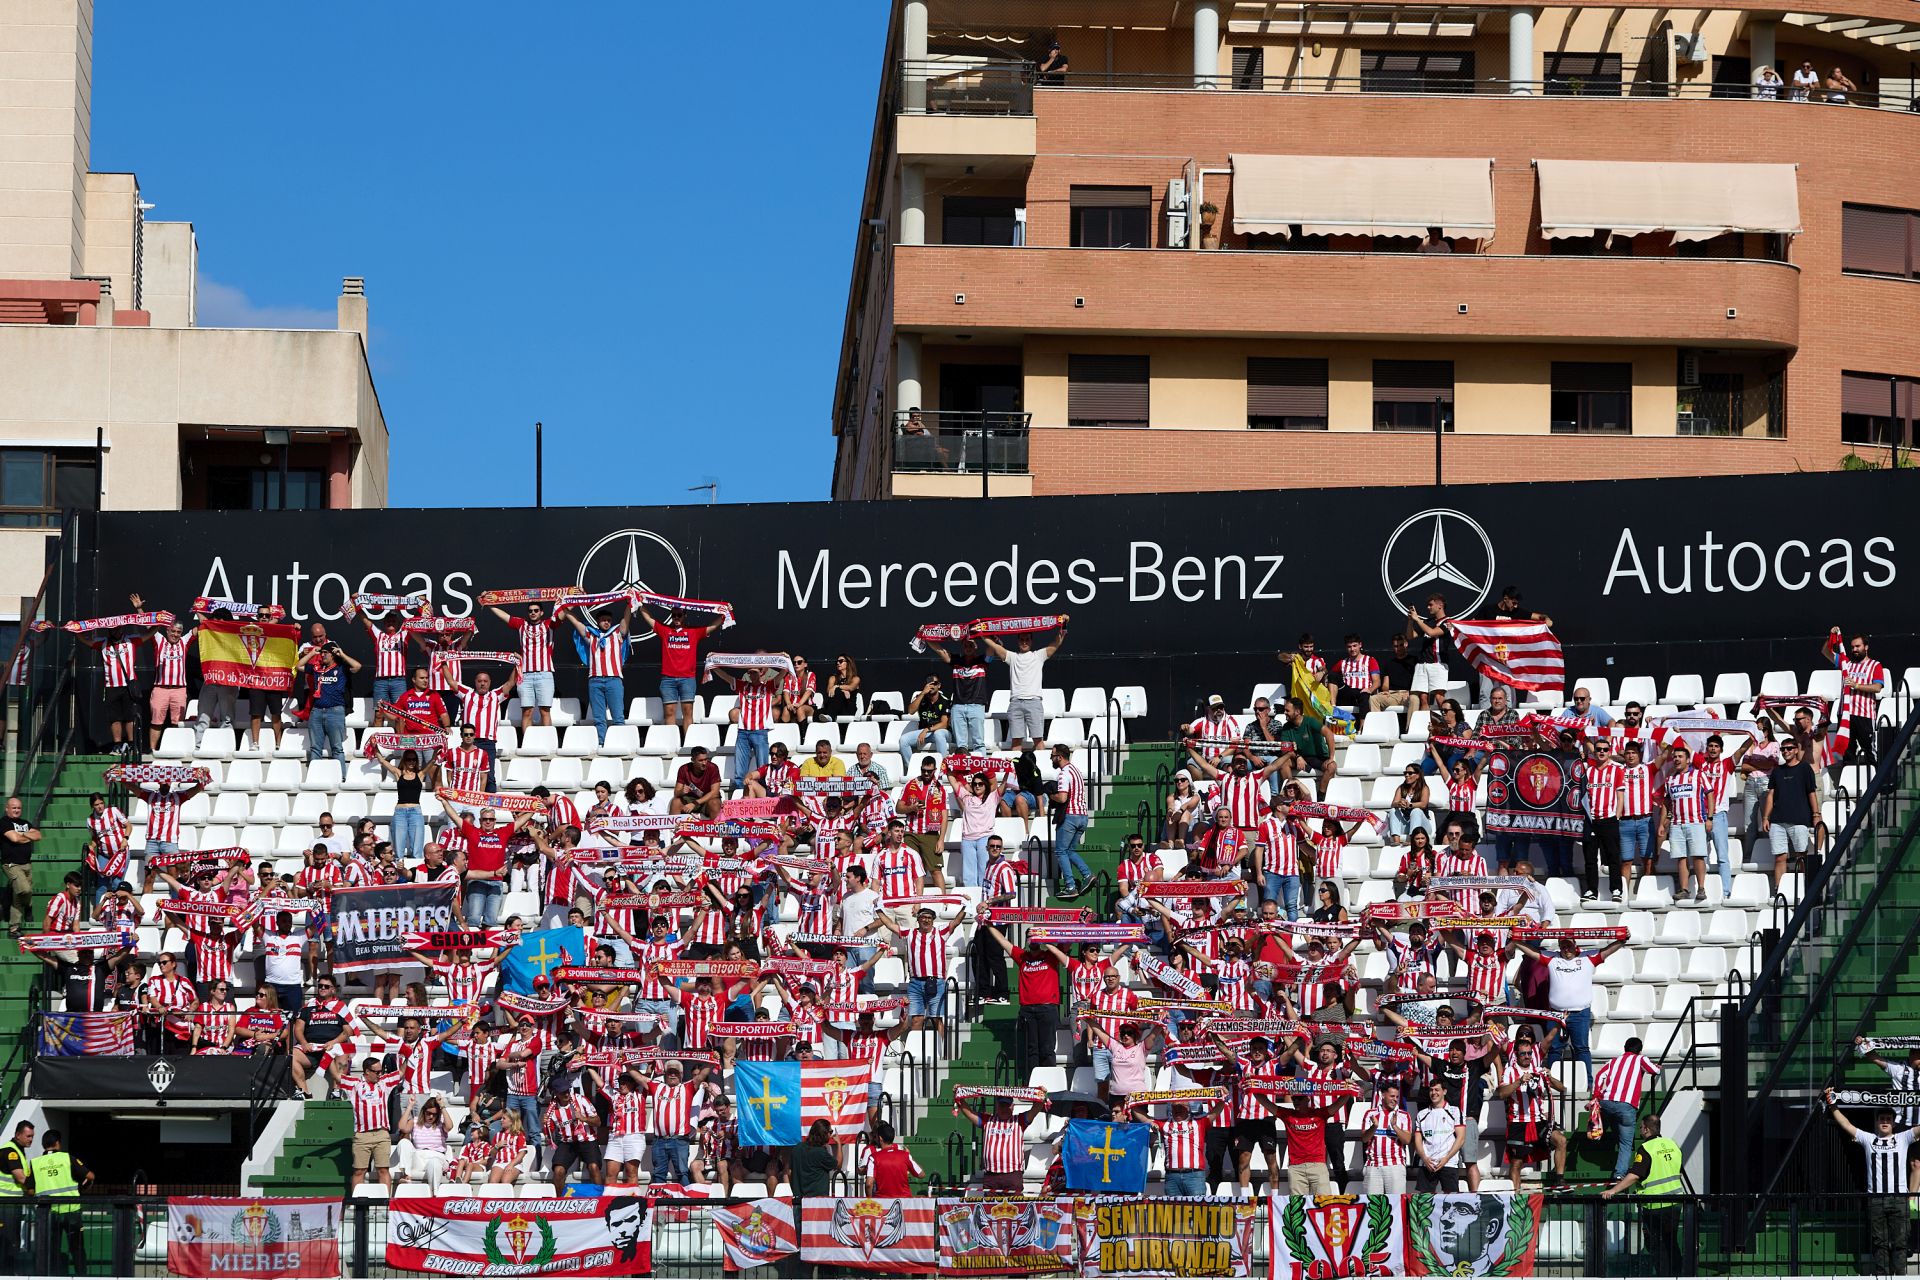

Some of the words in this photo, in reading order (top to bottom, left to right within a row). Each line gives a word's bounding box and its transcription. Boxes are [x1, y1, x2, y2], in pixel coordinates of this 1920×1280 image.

[1602, 527, 1897, 596] Autocas
[777, 541, 1285, 611] Mercedes-Benz
[196, 556, 473, 622] Autocas
[99, 617, 128, 628] SPORTING
[1001, 618, 1032, 631] SPORTING
[961, 757, 1010, 770] SPORTING
[126, 765, 193, 781] SPORTING
[795, 780, 812, 793] REAL
[812, 780, 845, 793] SPORTING
[612, 818, 631, 828] Real
[1512, 814, 1553, 830] AWAY
[690, 824, 705, 833] Real
[706, 823, 740, 834] SPORTING
[741, 826, 750, 834] de
[751, 826, 768, 836] Gijón
[164, 901, 181, 910] Real
[182, 901, 226, 914] SPORTING
[337, 906, 449, 947] MIERES
[1479, 918, 1519, 928] SPORTING
[81, 934, 118, 945] BENIDORM
[568, 969, 599, 978] SPORTING
[616, 970, 626, 978] DE
[1161, 965, 1201, 996] SPORTING
[716, 1024, 733, 1034] Real
[735, 1023, 785, 1034] SPORTING
[626, 1051, 641, 1060] Real
[1180, 1046, 1216, 1059] SPORTING
[1354, 1041, 1387, 1055] SPORTING
[1388, 1048, 1397, 1057] de
[1258, 1080, 1274, 1090] Real
[1275, 1080, 1311, 1091] SPORTING
[1312, 1081, 1321, 1090] de
[1322, 1081, 1341, 1093] Gijón
[1131, 1092, 1145, 1101] TE
[1145, 1090, 1174, 1100] QUIERO
[1175, 1088, 1215, 1098] SPORTING
[47, 1168, 59, 1177] 59
[443, 1200, 483, 1214] PEÑA
[485, 1199, 598, 1214] SPORTINGUISTA
[1097, 1203, 1236, 1238] SENTIMIENTO
[210, 1251, 301, 1272] MIERES
[1099, 1237, 1232, 1273] ROJIBLANCO
[423, 1254, 483, 1275] ENRIQUE
[583, 1250, 614, 1267] BCN
[951, 1255, 1006, 1269] SENTIMIENTO
[1288, 1252, 1392, 1280] 1905
